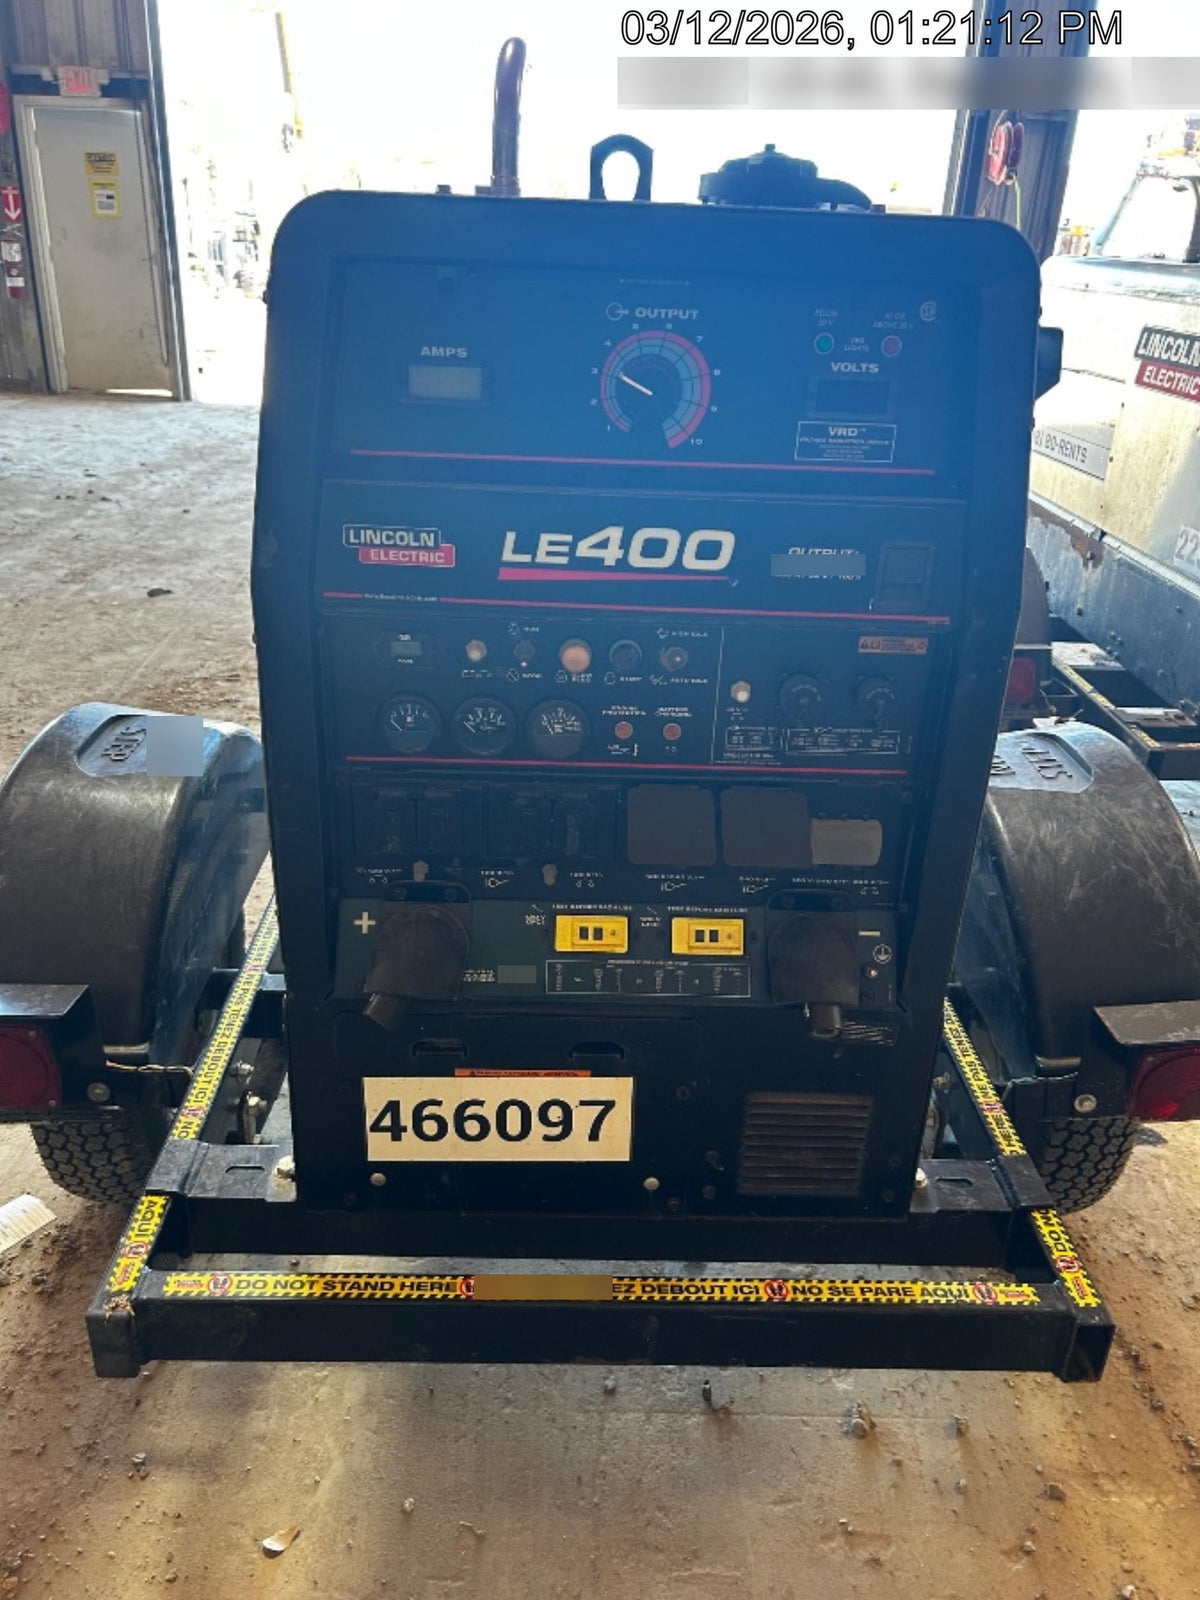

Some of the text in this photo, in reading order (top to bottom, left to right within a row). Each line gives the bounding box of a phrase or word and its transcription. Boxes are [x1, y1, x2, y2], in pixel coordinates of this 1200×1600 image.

[635, 306, 699, 320] OUTPUT
[420, 345, 468, 358] AMPS
[830, 361, 880, 374] VOLTS
[1143, 366, 1200, 396] ELECTRIC
[690, 437, 703, 446] 10
[349, 528, 435, 547] LINCOLN
[369, 548, 445, 564] ELECTRIC
[501, 526, 735, 571] LE400
[200, 1041, 228, 1087] DEBOUT
[193, 1088, 208, 1103] ICI
[369, 1098, 616, 1142] 466097
[1048, 1229, 1068, 1252] DO
[236, 1279, 458, 1292] DO NOT STAND HERE
[641, 1284, 728, 1295] DEBOUT
[732, 1285, 760, 1295] ICI
[792, 1285, 969, 1299] NO SE PARE AQUI
